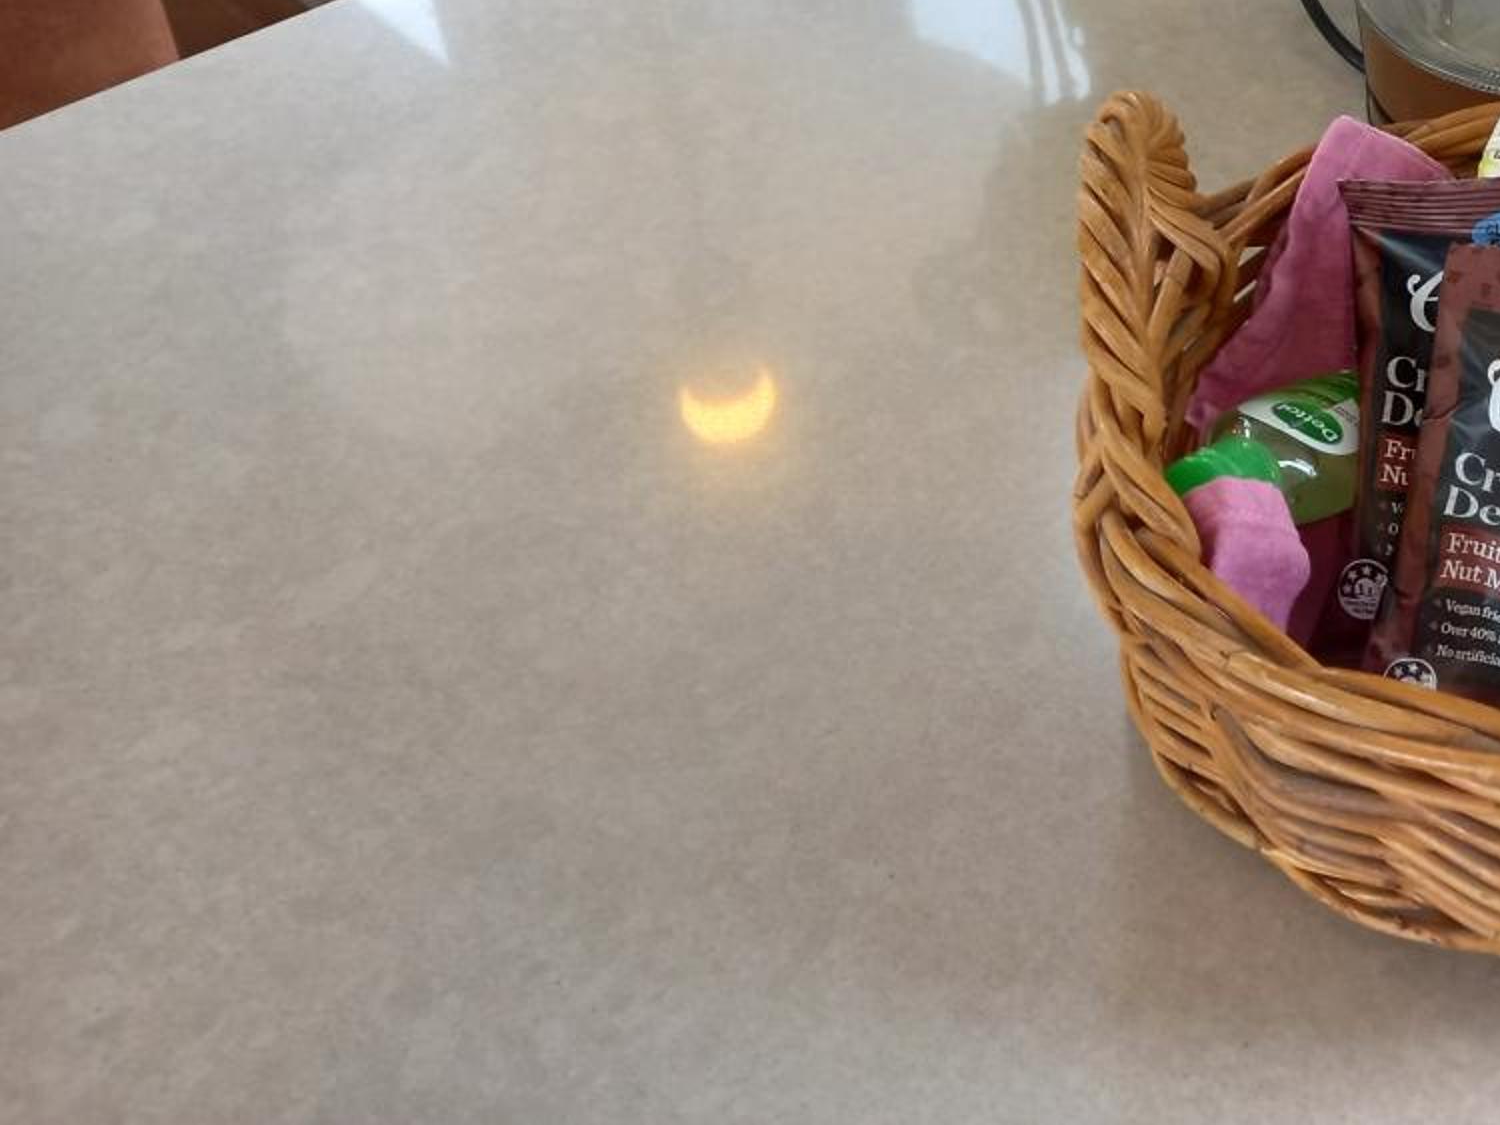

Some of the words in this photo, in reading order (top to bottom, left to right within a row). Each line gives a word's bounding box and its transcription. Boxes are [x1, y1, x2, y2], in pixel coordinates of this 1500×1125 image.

[1276, 404, 1339, 442] Dettol
[1440, 559, 1483, 585] Nut
[1445, 598, 1481, 617] Vegan
[1440, 621, 1468, 638] Over
[1470, 626, 1497, 644] 40%
[1436, 643, 1455, 658] No
